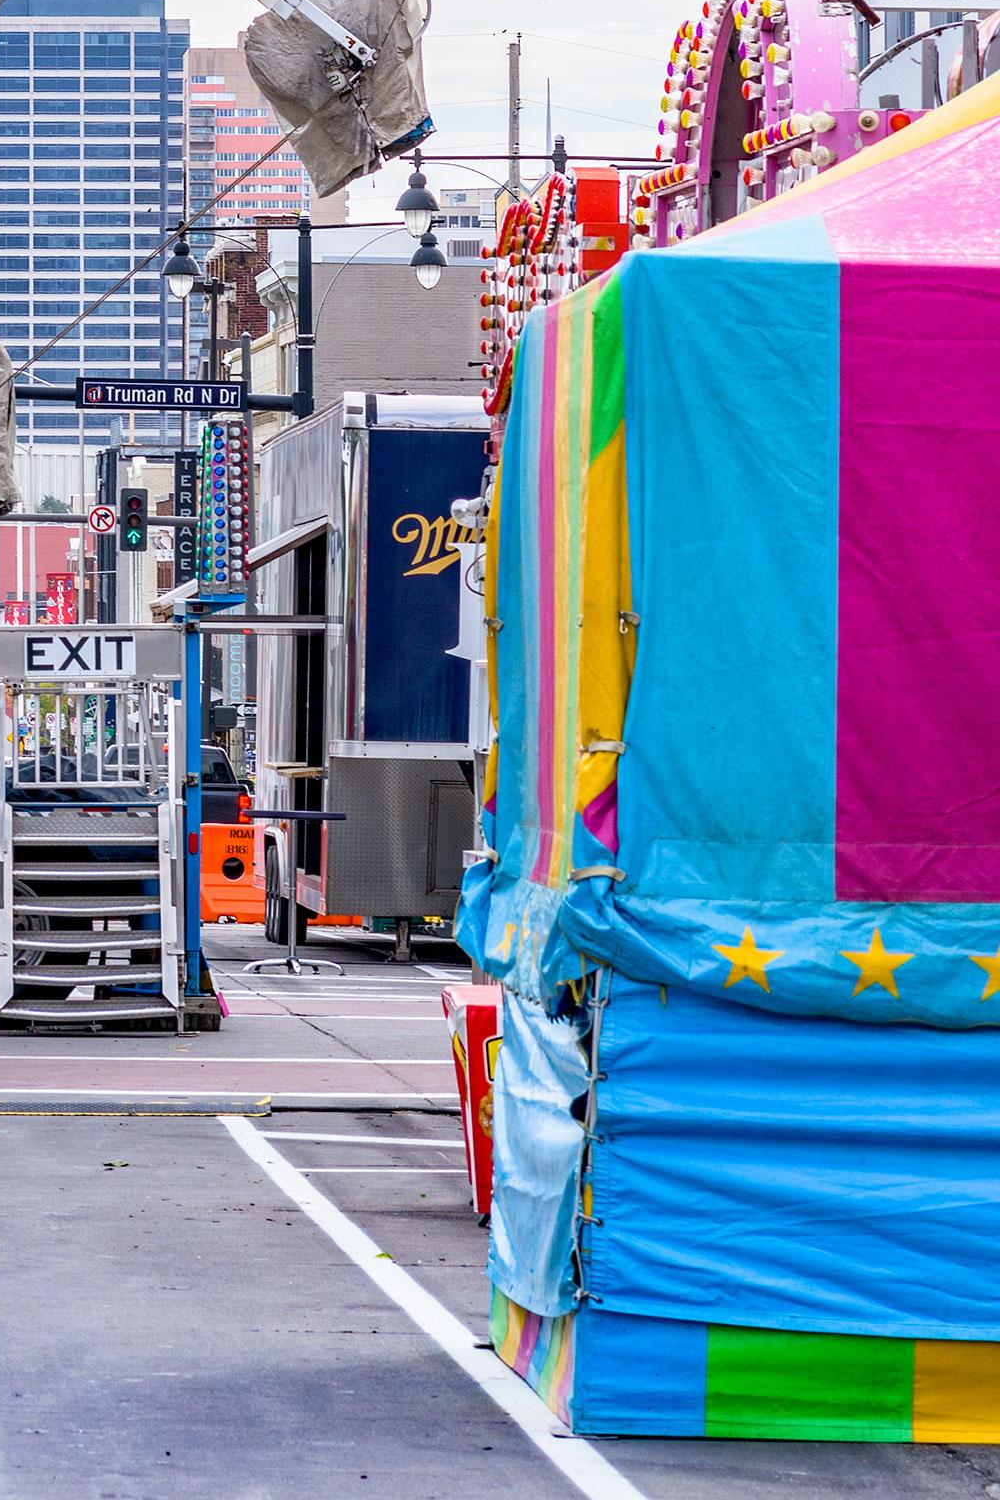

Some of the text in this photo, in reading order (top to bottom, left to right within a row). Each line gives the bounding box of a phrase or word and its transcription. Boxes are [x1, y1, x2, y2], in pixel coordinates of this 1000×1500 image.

[105, 386, 238, 404] Truman Rd N Dr
[180, 458, 193, 570] TERRACE
[26, 636, 134, 671] EXIT
